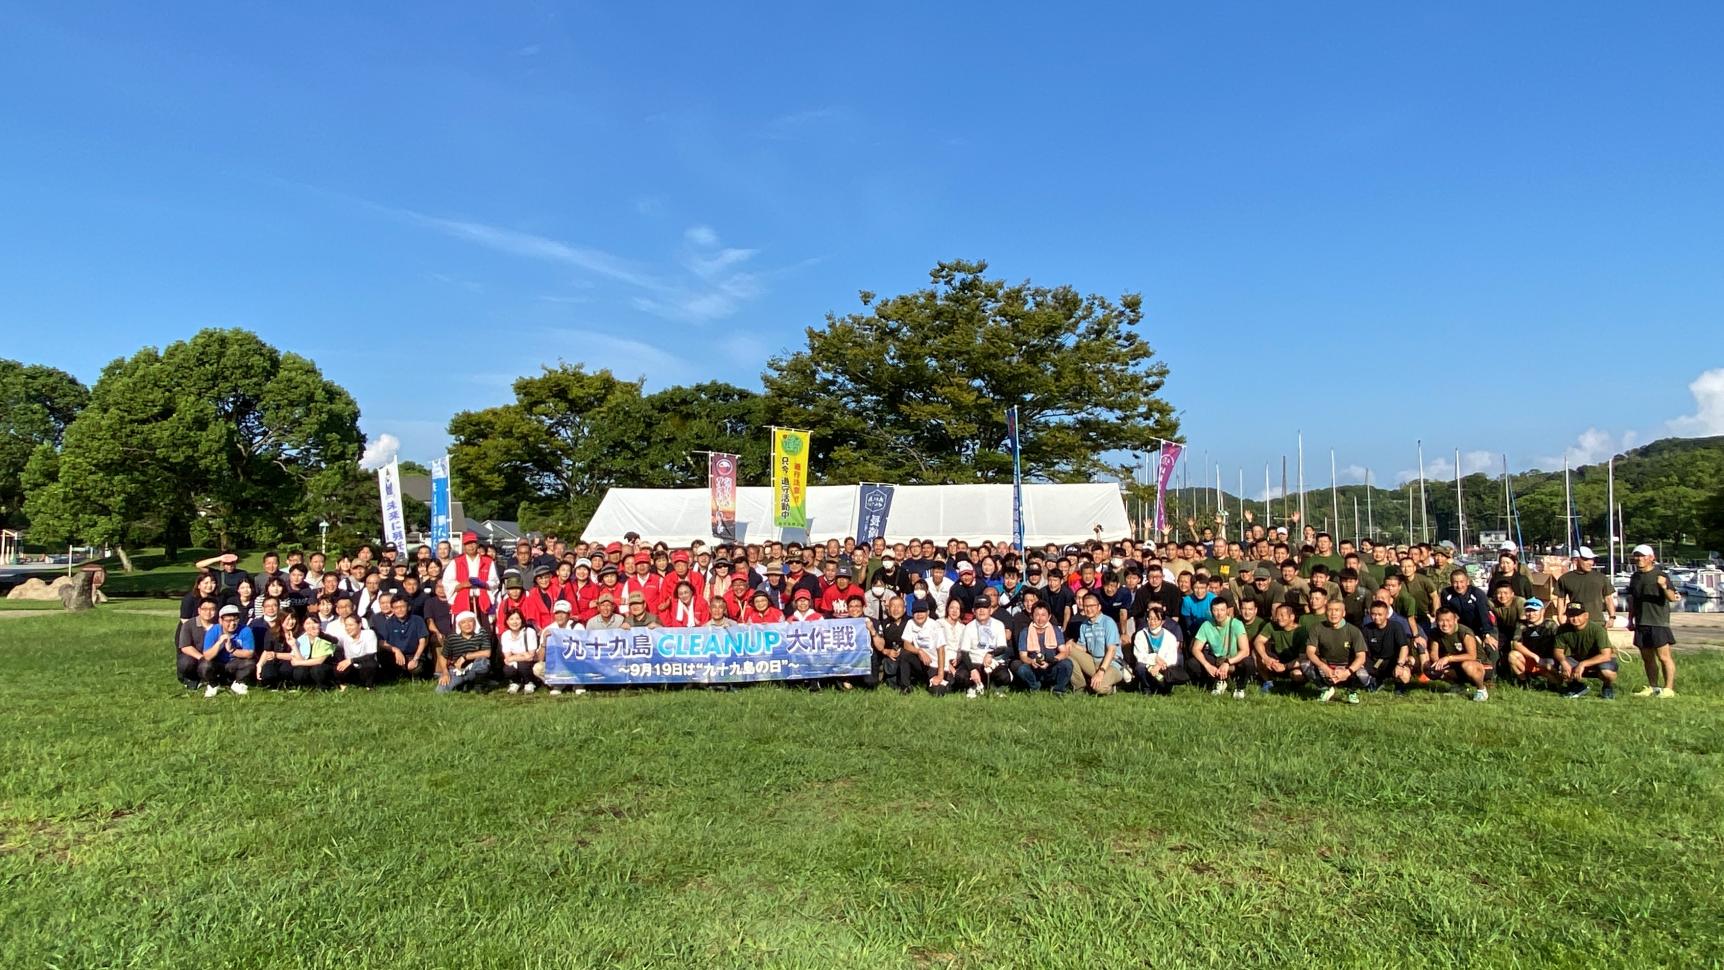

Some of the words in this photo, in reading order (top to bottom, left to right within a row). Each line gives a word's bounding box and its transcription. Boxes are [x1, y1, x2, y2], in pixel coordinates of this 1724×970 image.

[562, 635, 652, 659] 九十九島
[656, 630, 780, 657] CLEANUP
[786, 625, 855, 653] 大作戦
